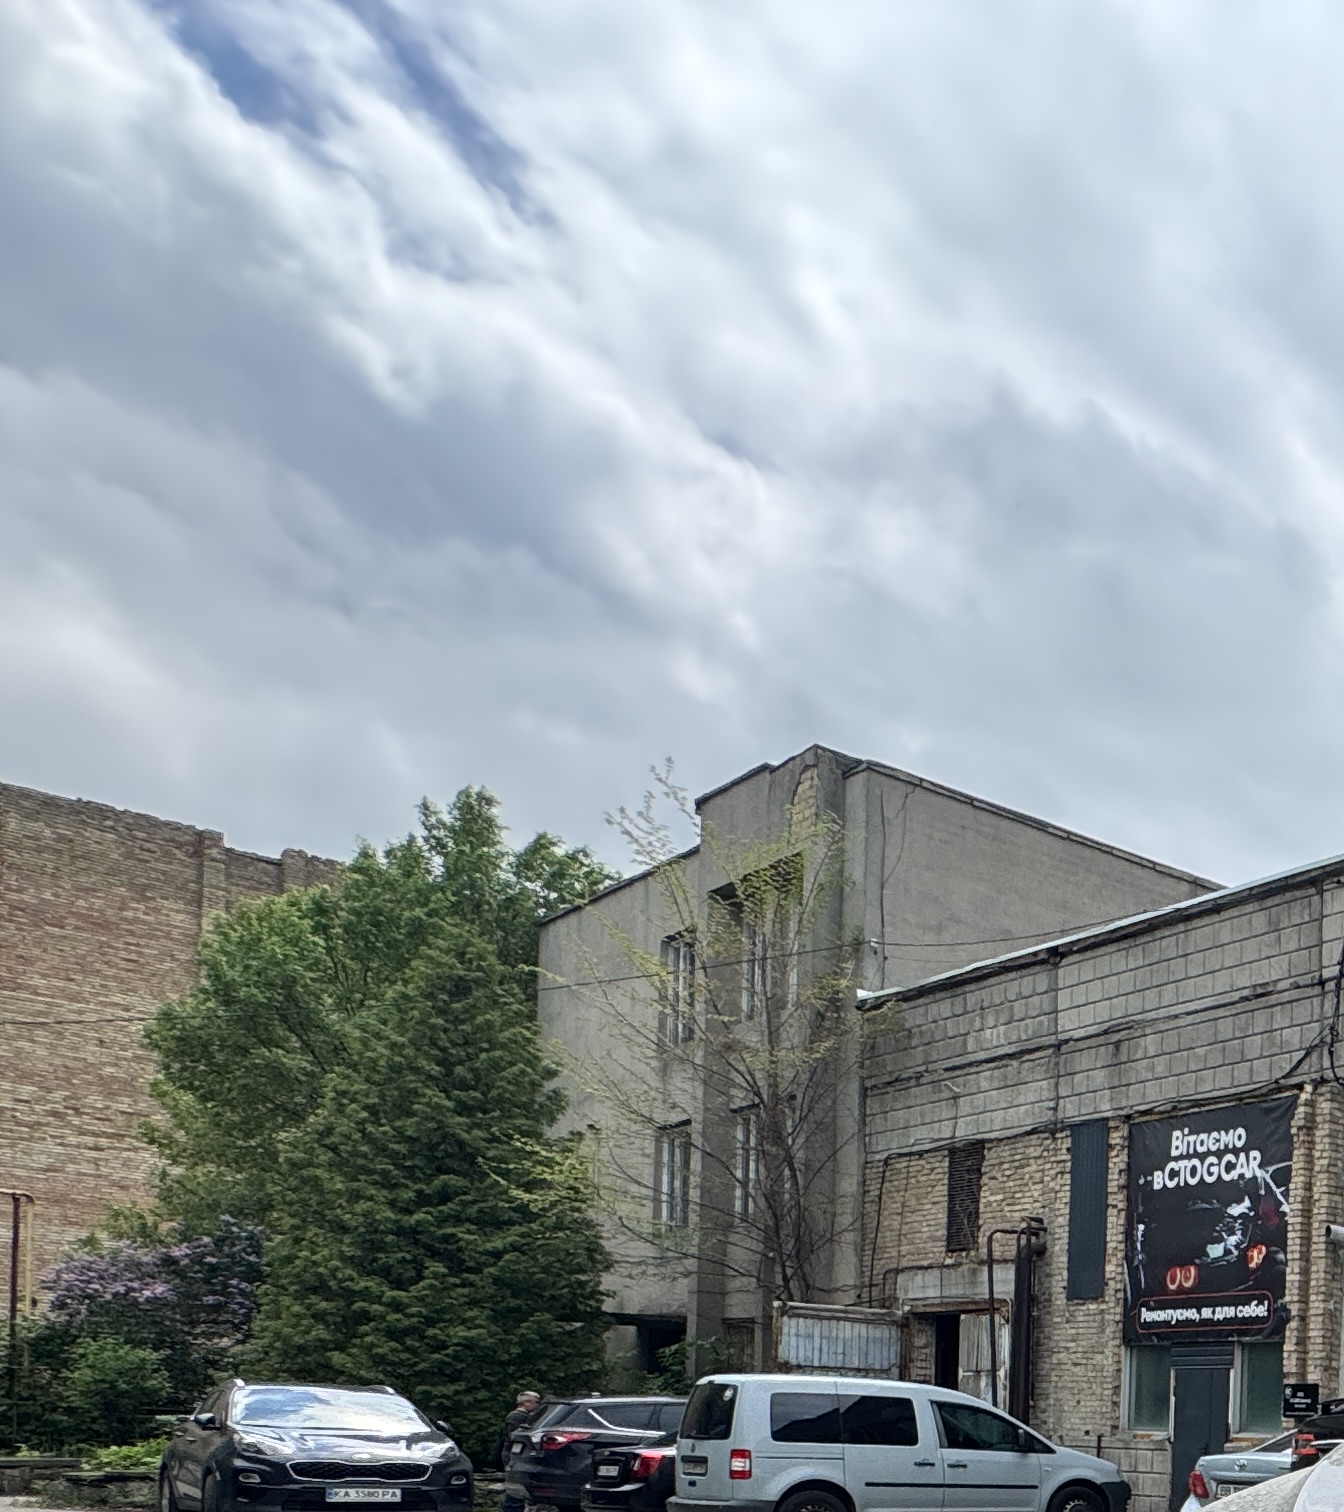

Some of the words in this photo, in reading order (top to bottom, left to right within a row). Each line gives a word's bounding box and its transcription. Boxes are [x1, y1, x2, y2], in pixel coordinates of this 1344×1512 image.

[1170, 1127, 1247, 1157] Вітаємо
[1214, 1305, 1236, 1321] для
[1236, 1300, 1269, 1318] себе!
